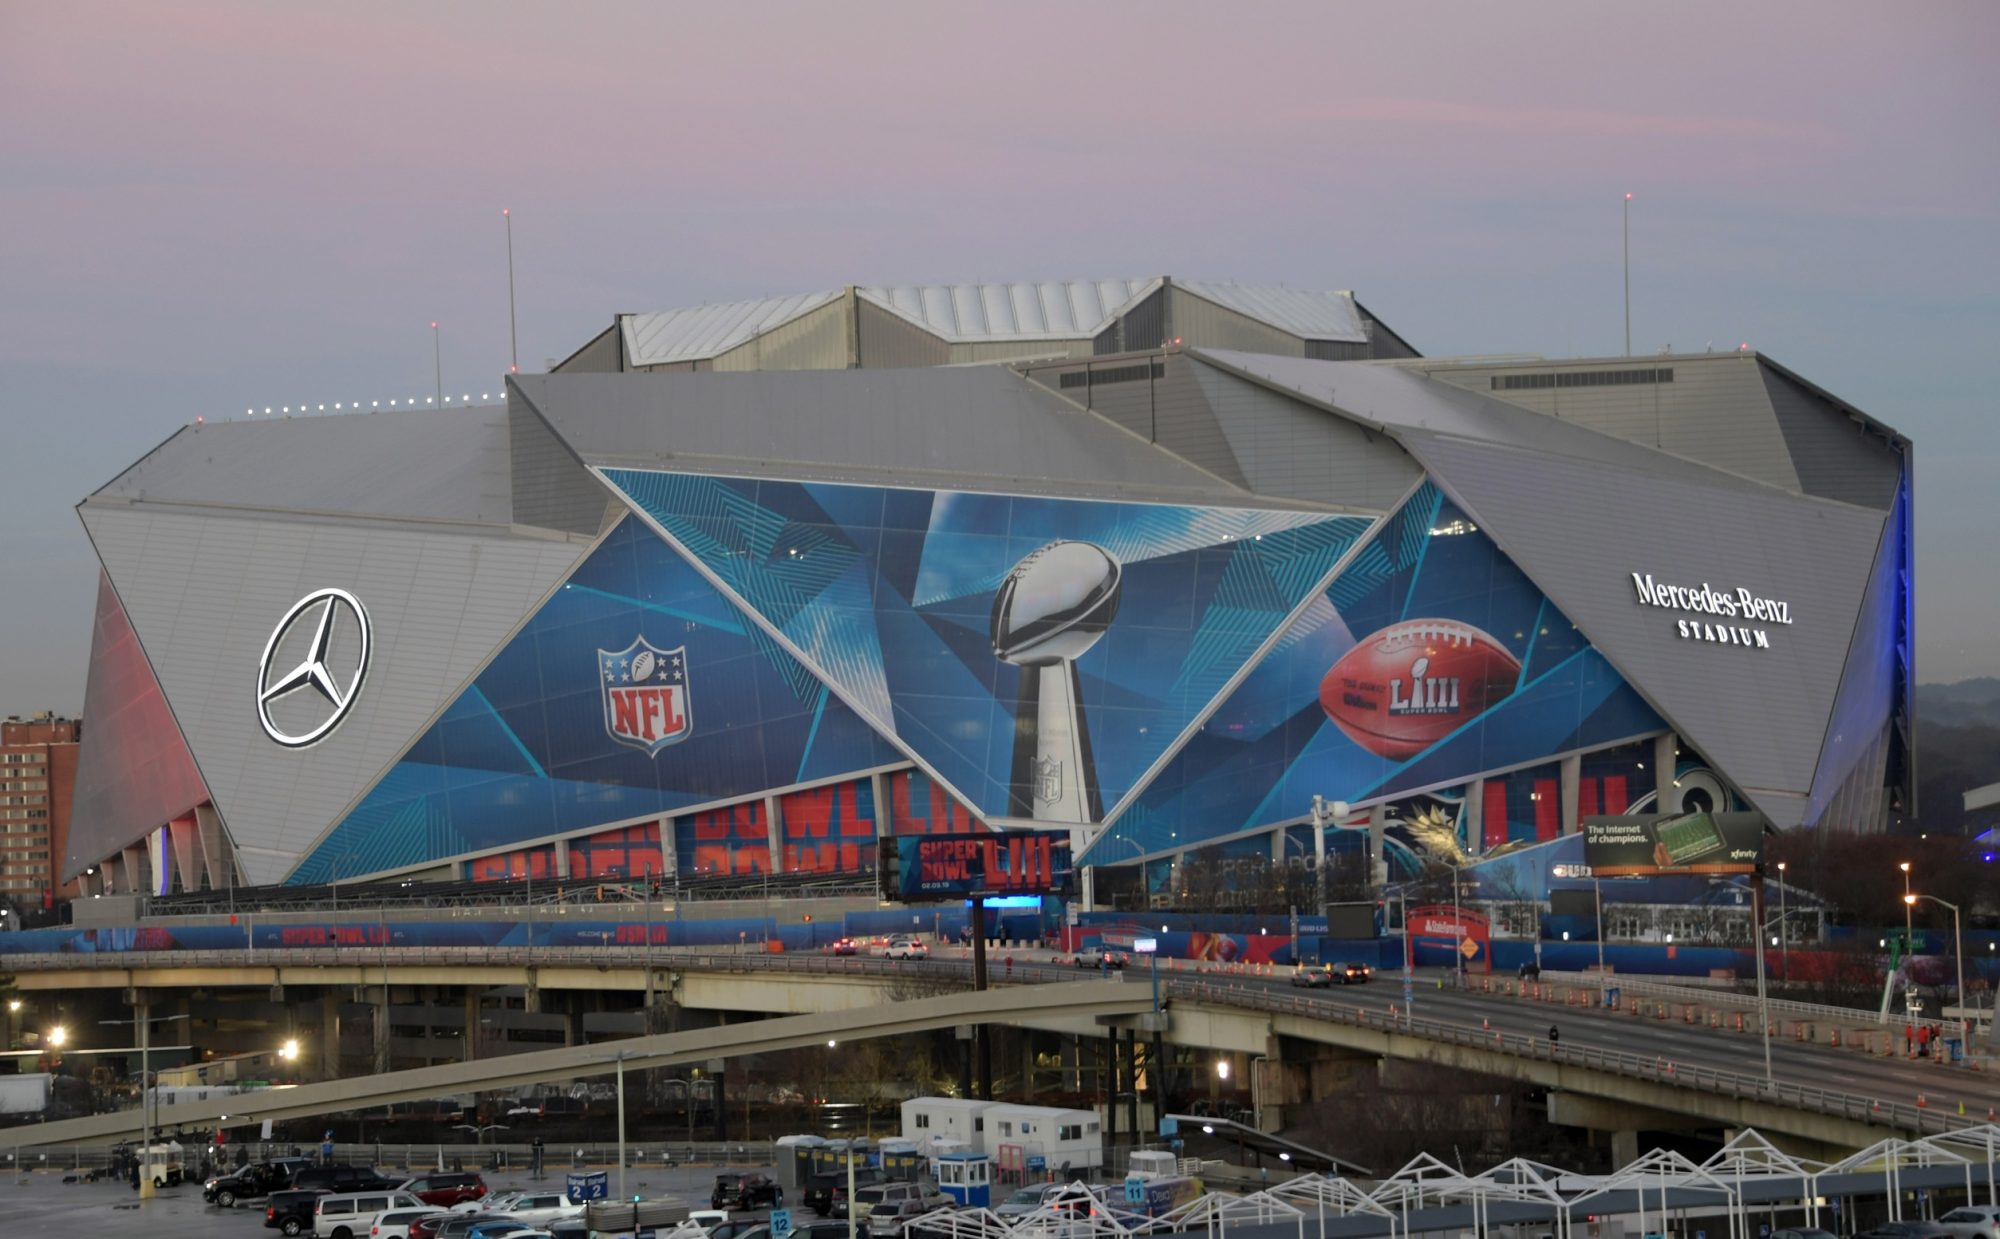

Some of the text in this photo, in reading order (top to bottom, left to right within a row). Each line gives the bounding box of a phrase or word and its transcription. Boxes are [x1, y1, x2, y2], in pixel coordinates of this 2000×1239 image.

[1632, 572, 1793, 625] Mercedes-Benz
[1677, 619, 1770, 649] STADIUM
[611, 688, 684, 741] NFL
[1588, 825, 1641, 835] The Internet
[1588, 834, 1648, 845] of champions.
[920, 839, 976, 860] SUPER
[1731, 850, 1757, 860] xfinity
[922, 836, 1052, 888] BOWL LIII
[572, 1185, 581, 1198] 2
[592, 1185, 601, 1198] 2
[1129, 1187, 1141, 1199] 11
[774, 1219, 787, 1231] 12
